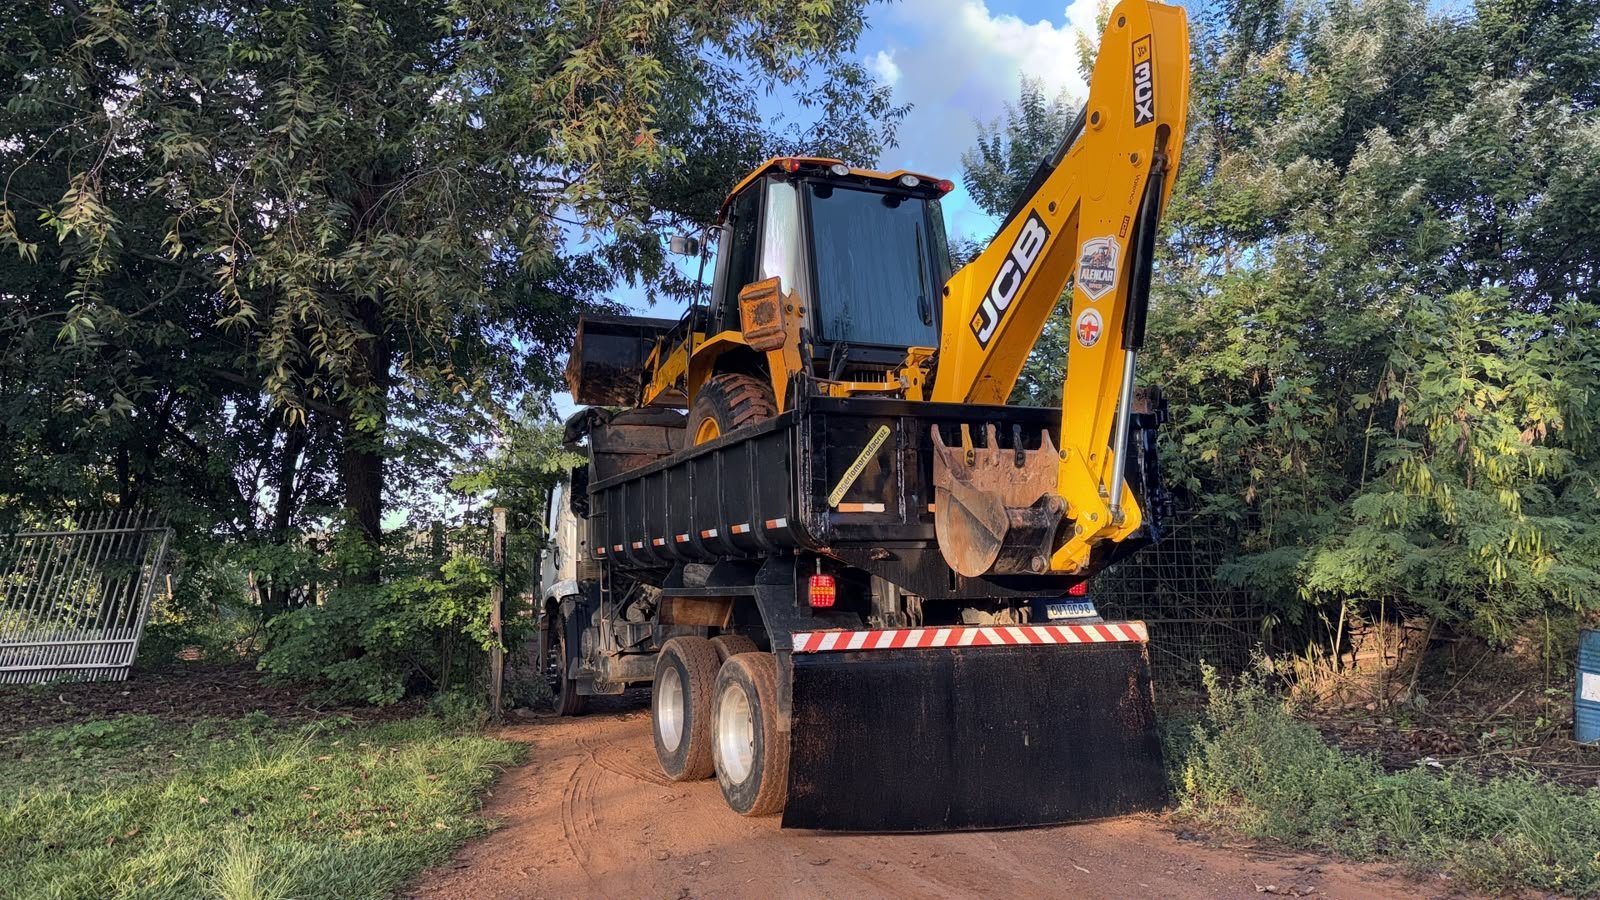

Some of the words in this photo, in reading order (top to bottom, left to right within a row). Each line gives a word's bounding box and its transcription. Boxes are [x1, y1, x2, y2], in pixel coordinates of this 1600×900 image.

[1134, 61, 1154, 124] 3CX
[978, 217, 1046, 343] JCB
[1080, 268, 1114, 282] ALENCAR
